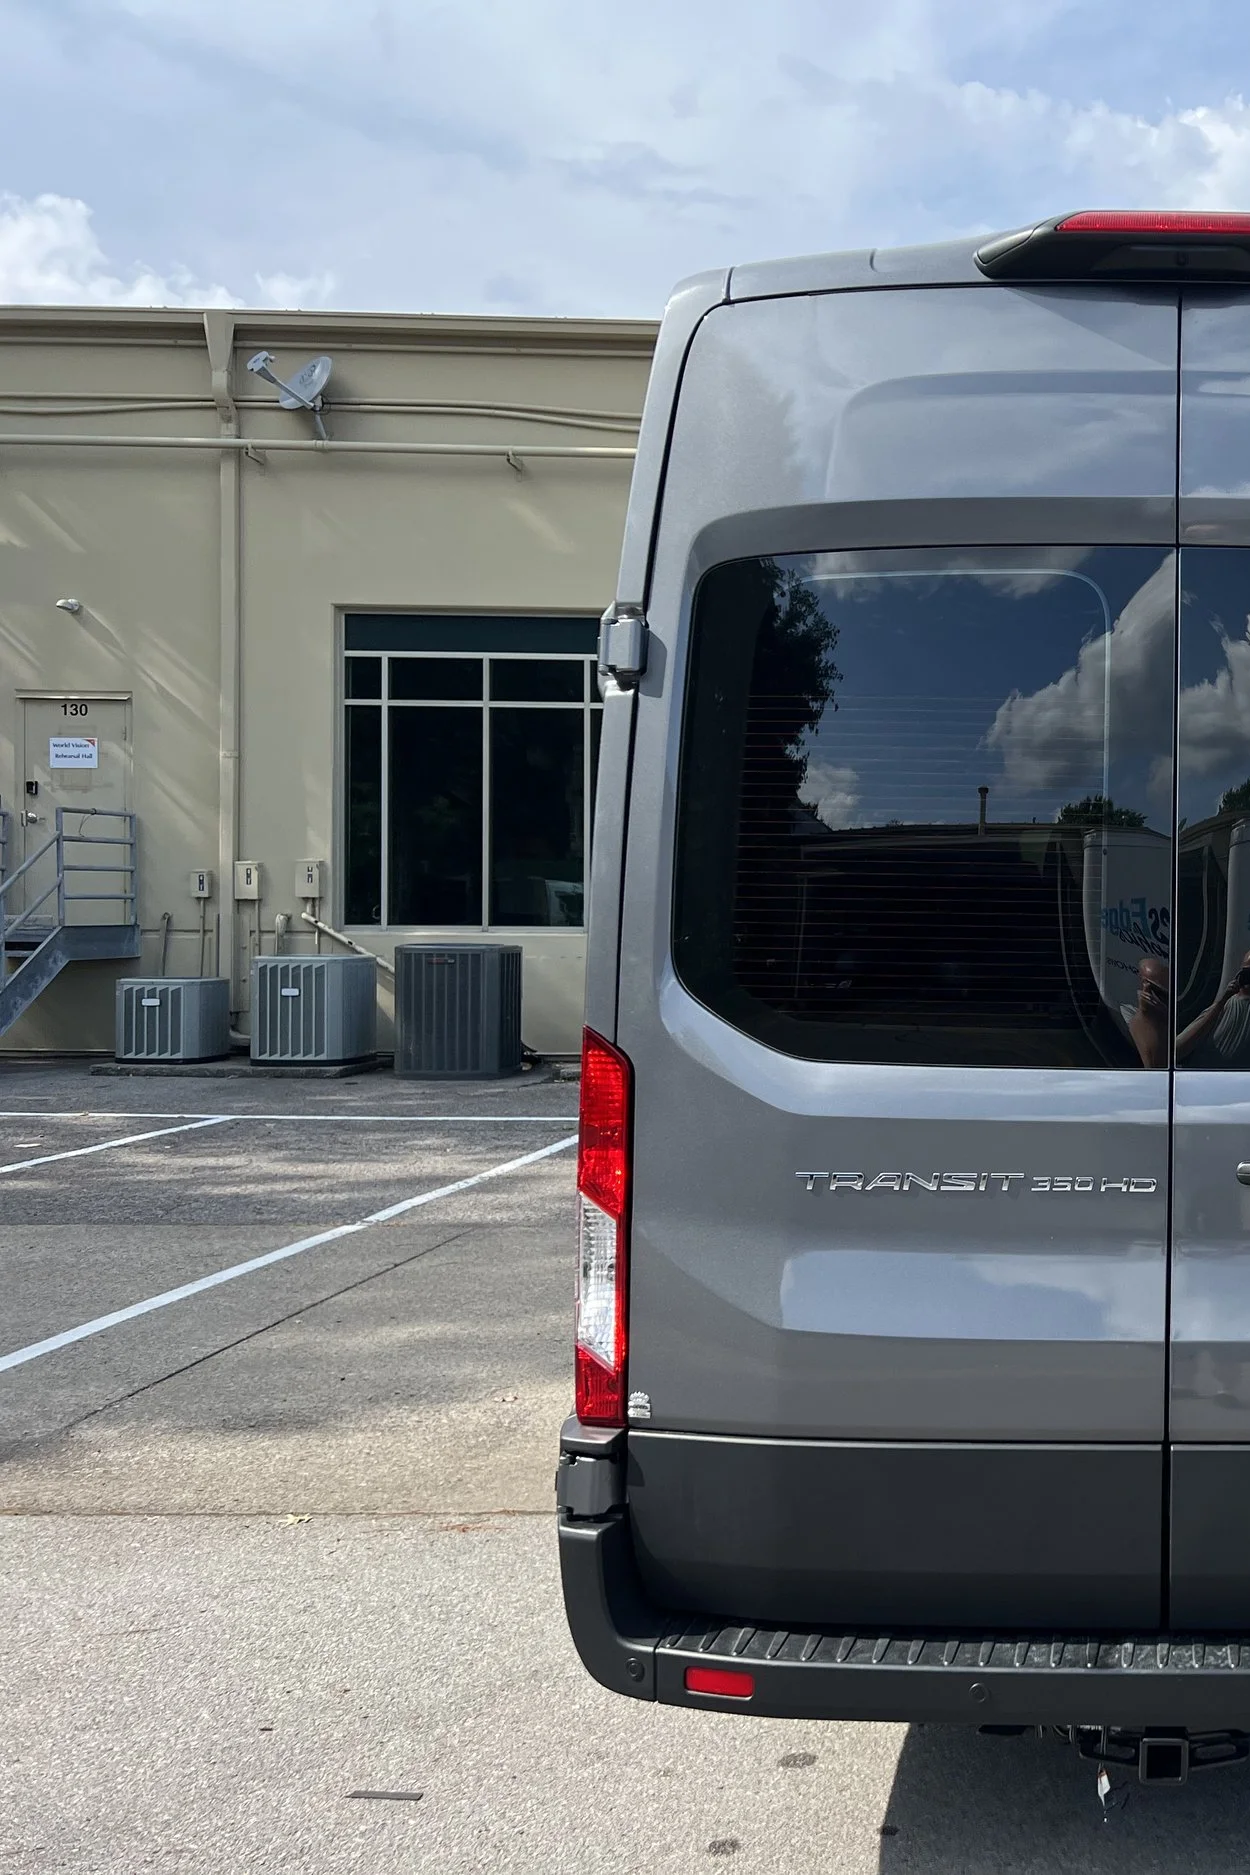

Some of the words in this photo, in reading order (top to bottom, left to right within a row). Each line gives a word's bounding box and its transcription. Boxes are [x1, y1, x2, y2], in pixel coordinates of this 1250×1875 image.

[60, 703, 88, 717] 130
[795, 1171, 1025, 1192] TRANSIT
[1031, 1176, 1094, 1192] 350
[1100, 1177, 1157, 1193] HD
